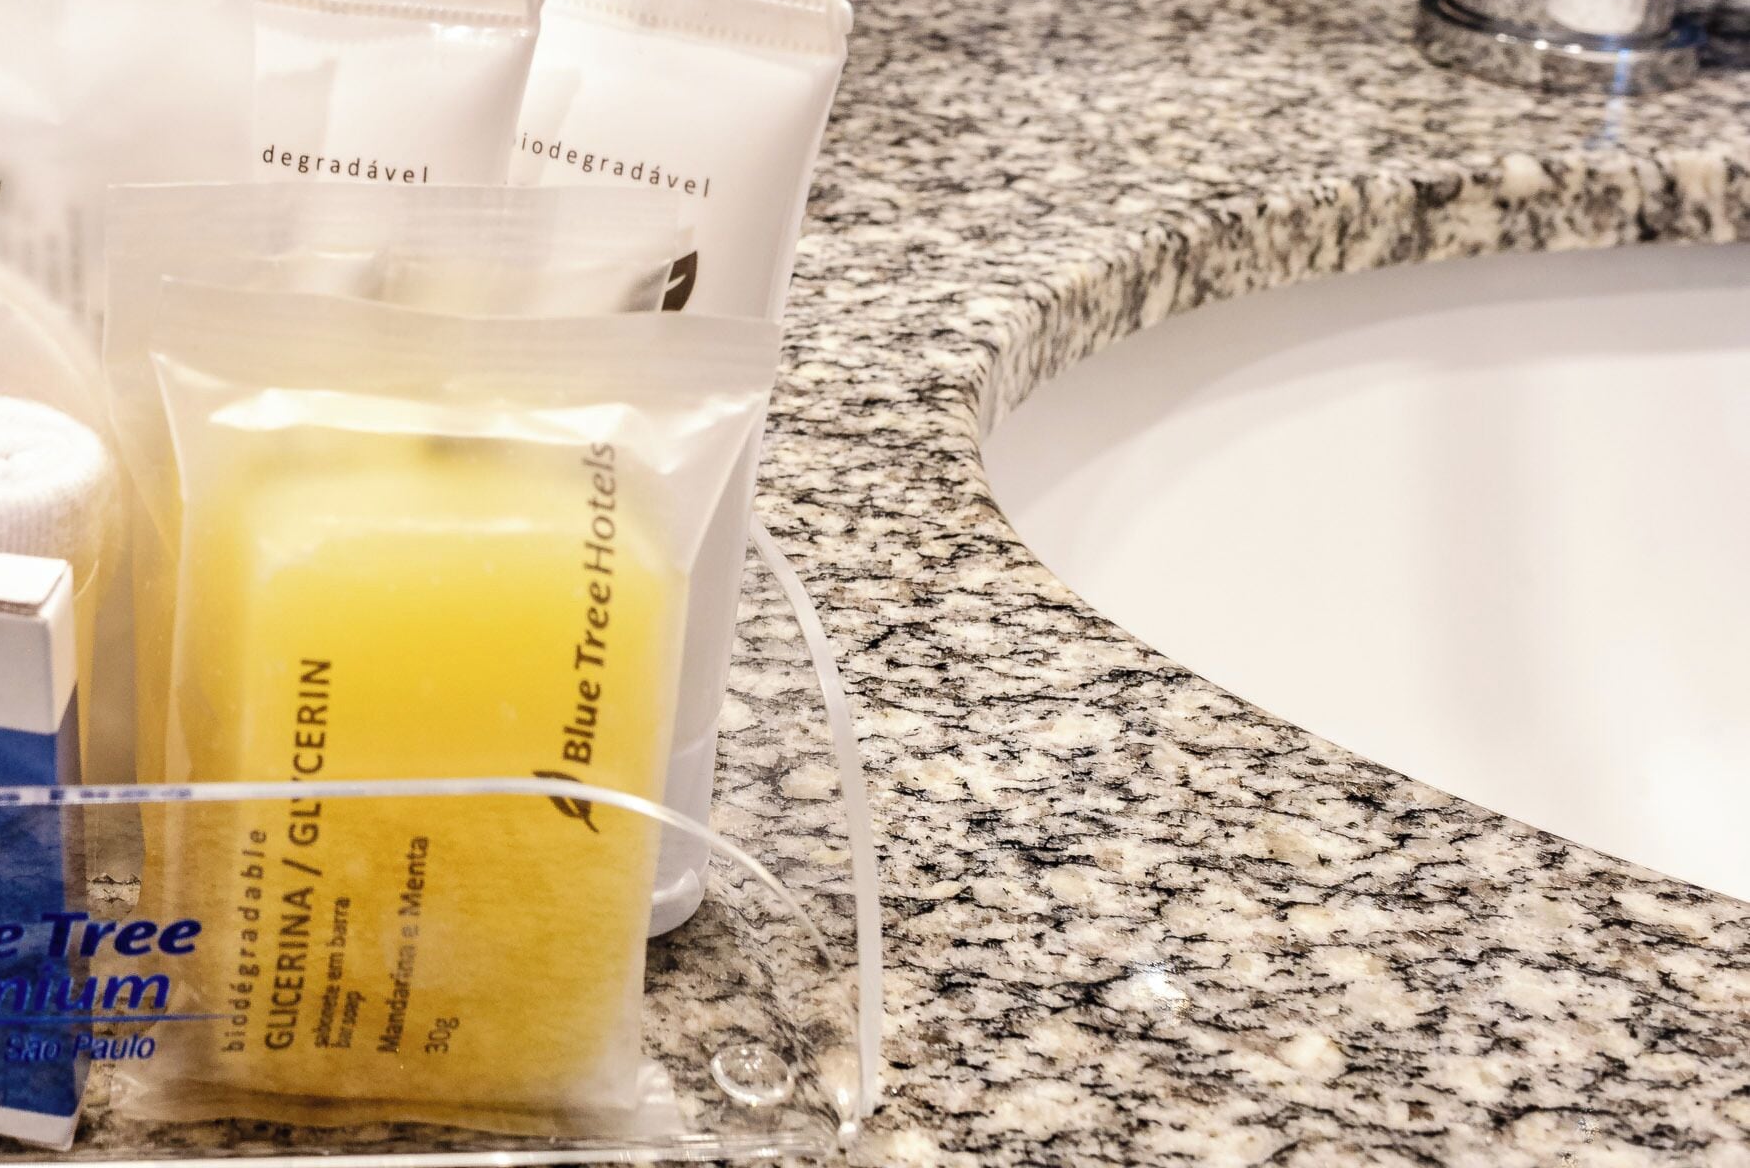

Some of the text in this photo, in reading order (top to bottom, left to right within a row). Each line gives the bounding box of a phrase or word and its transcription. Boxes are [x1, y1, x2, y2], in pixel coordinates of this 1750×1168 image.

[262, 144, 429, 184] degradável
[513, 131, 711, 198] iodegradável
[561, 679, 603, 767] Blue
[281, 856, 323, 878] /
[397, 835, 430, 917] Menta
[42, 910, 203, 958] Tree
[325, 895, 351, 949] barra
[263, 885, 315, 1051] GLICERINA
[74, 1032, 156, 1061] Paulo
[423, 1016, 461, 1055] 30g
